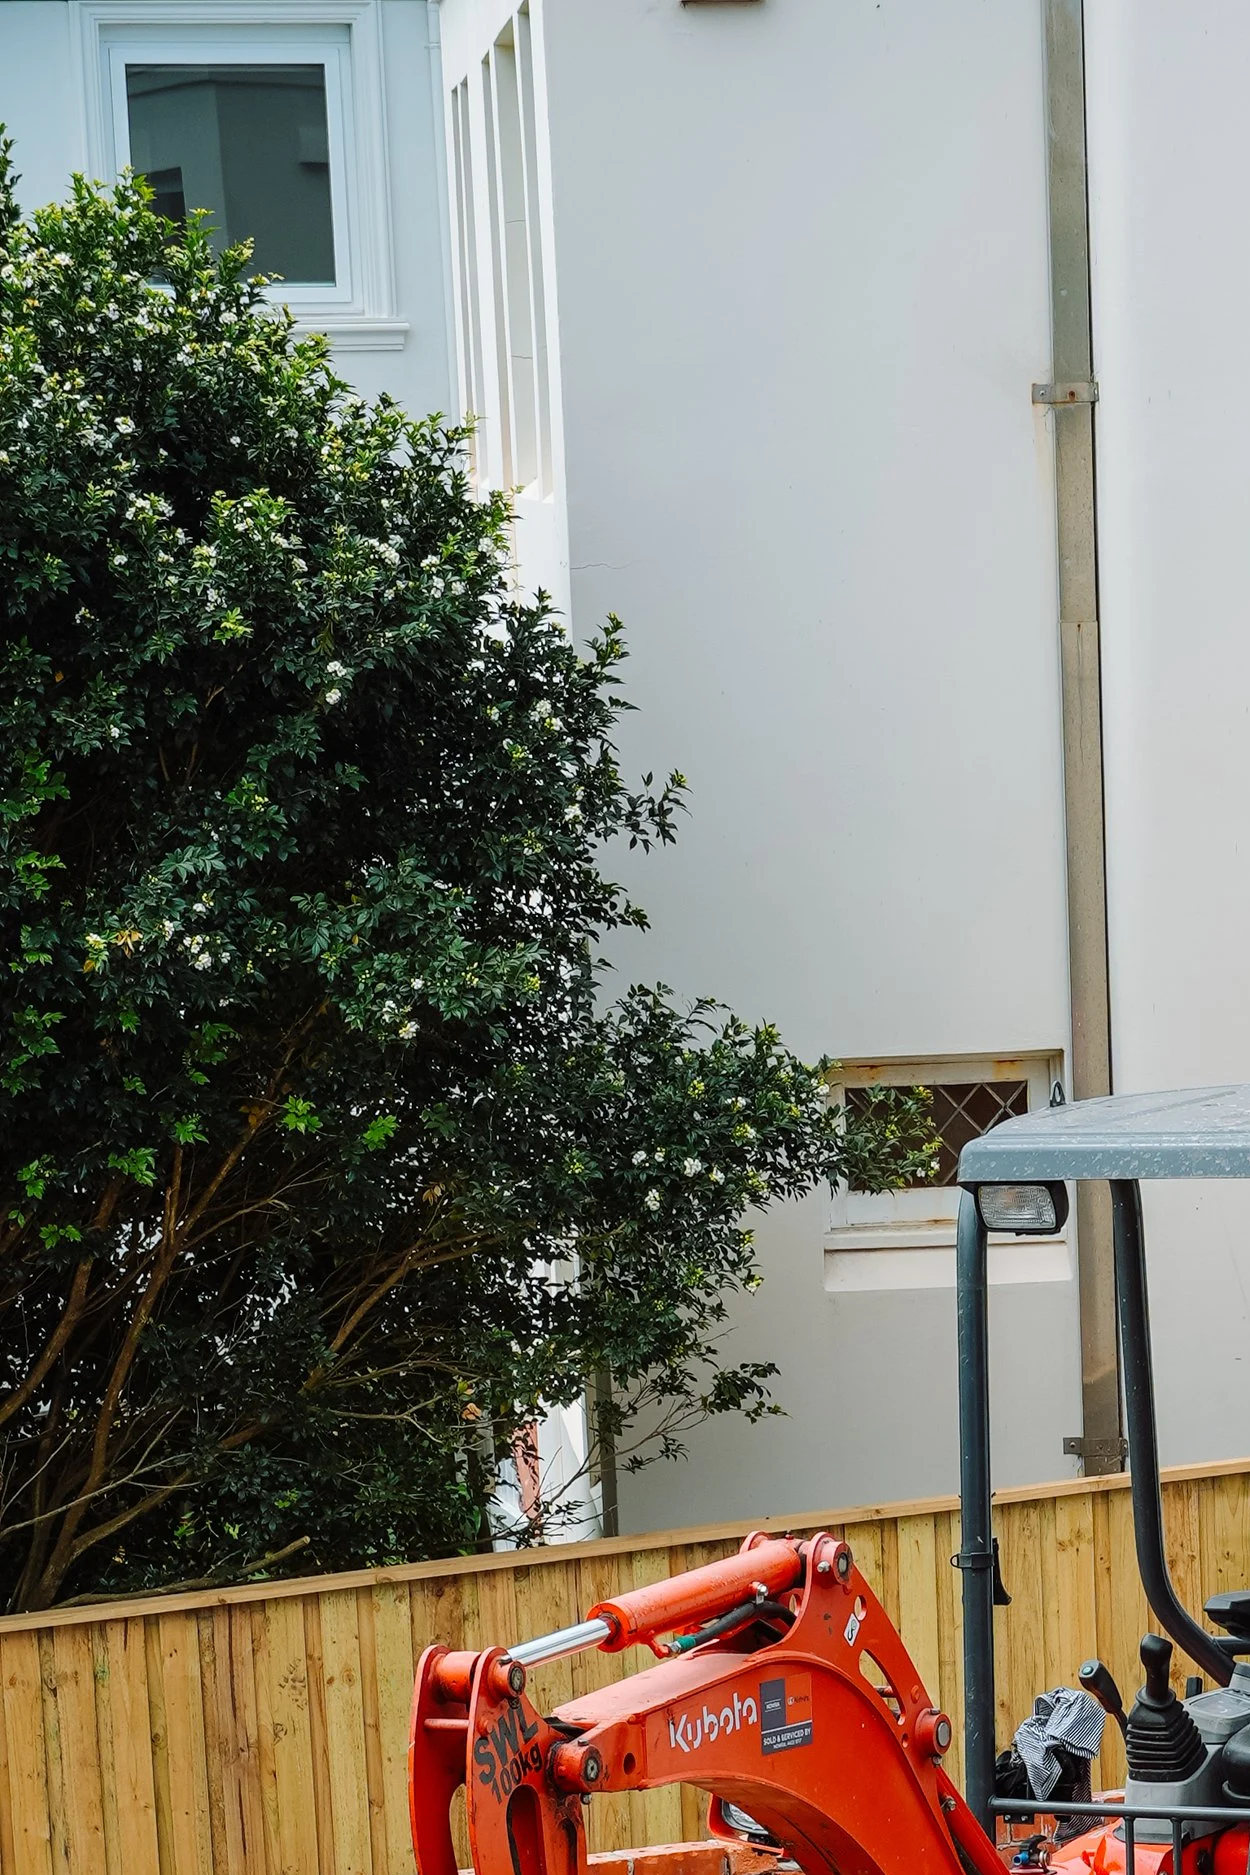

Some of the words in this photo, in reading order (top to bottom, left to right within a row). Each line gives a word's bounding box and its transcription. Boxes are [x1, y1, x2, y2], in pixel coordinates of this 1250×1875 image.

[474, 1699, 538, 1785] SWL
[669, 1692, 758, 1753] Kubota
[763, 1735, 776, 1746] SOLD
[781, 1729, 804, 1742] SERVICED
[491, 1742, 543, 1805] 100kg
